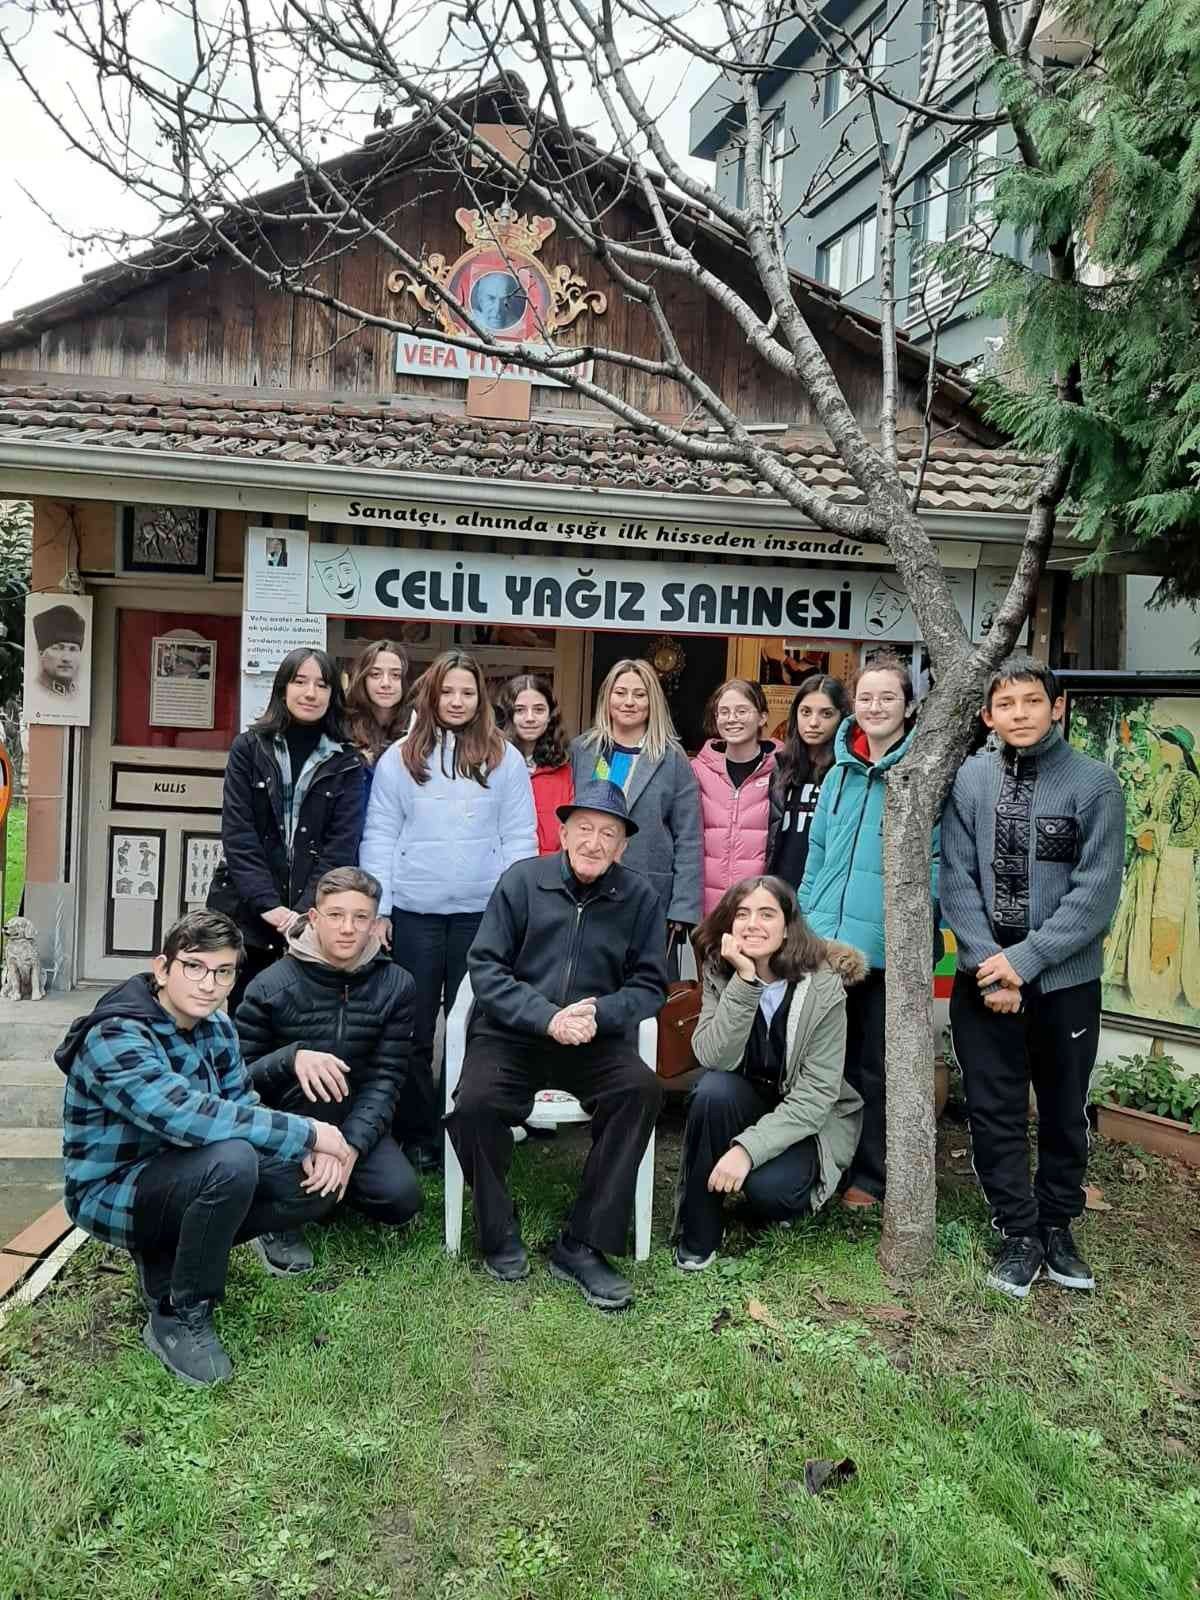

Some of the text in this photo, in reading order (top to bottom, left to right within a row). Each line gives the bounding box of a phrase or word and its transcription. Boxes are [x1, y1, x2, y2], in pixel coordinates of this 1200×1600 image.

[403, 343, 458, 369] VEFA
[348, 502, 864, 556] Sanatçı, alnında ışığı ilk hisseden insandır.
[375, 561, 852, 630] CELİL YAĞIZ SAHNESİ
